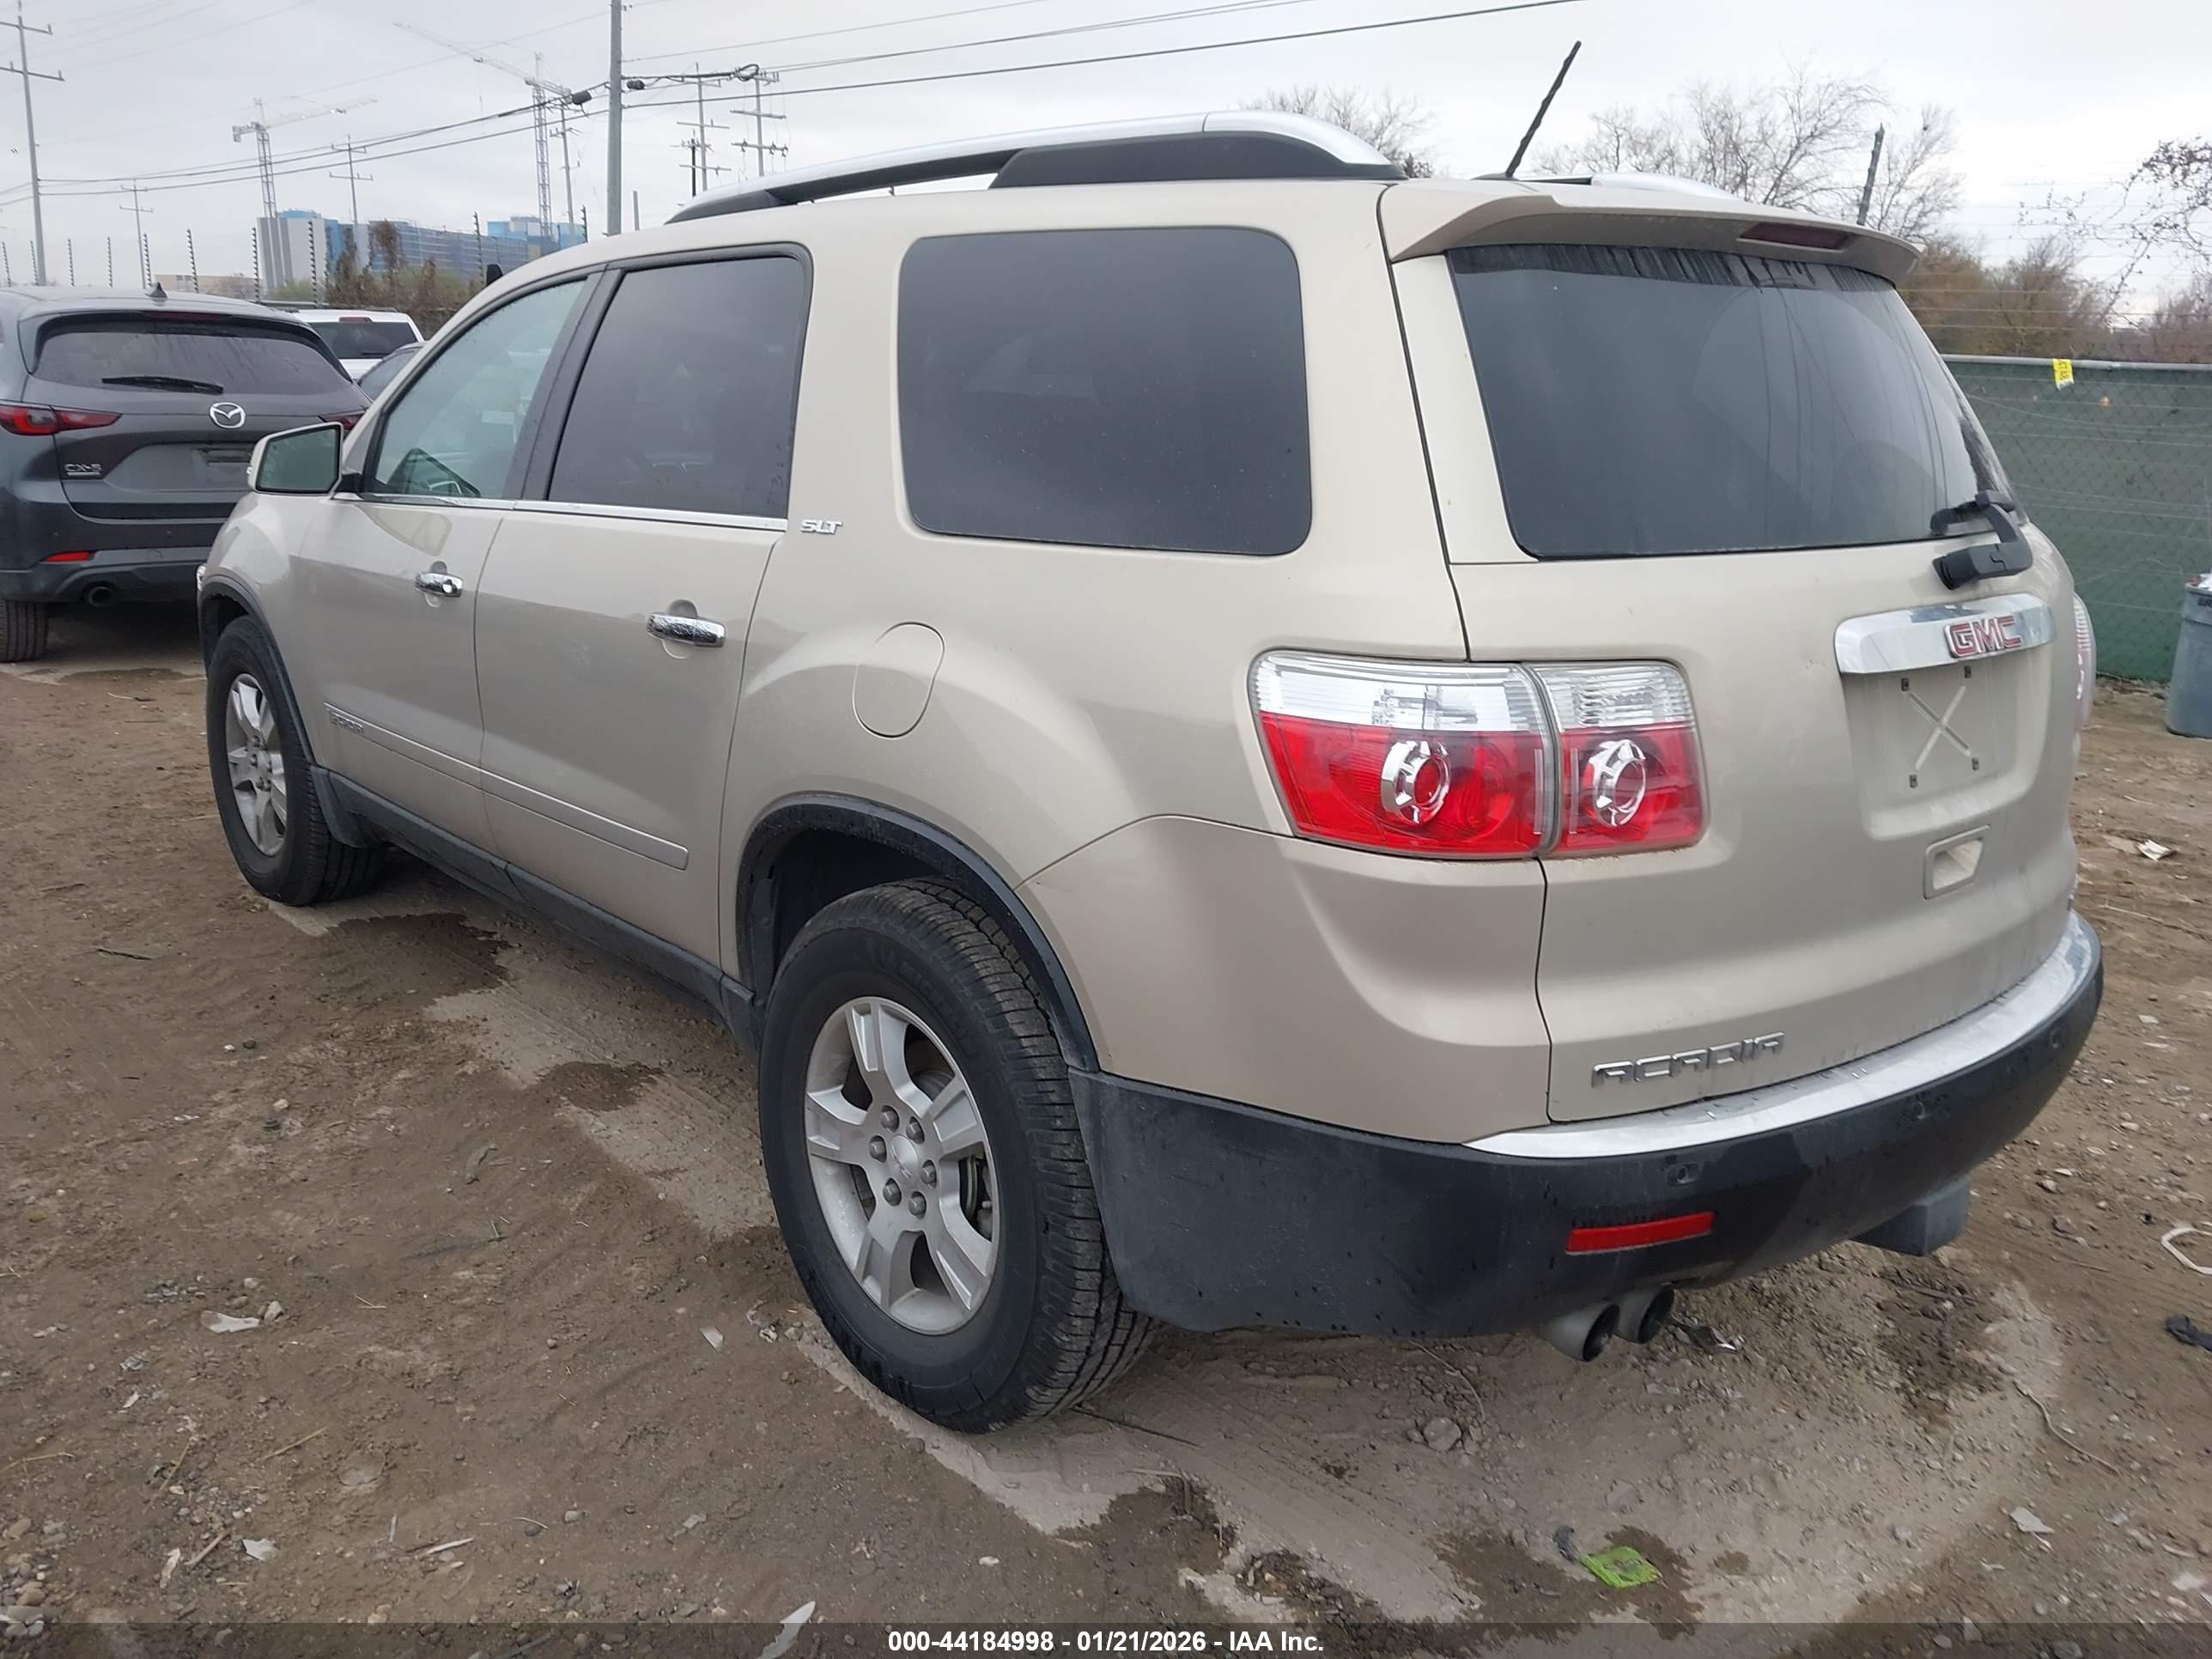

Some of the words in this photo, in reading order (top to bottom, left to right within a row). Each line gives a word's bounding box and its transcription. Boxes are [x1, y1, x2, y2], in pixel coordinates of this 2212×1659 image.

[64, 464, 102, 473] CX-5
[800, 520, 843, 534] SLT
[1944, 615, 2022, 658] GMC
[1591, 1031, 1785, 1087] ACADIA
